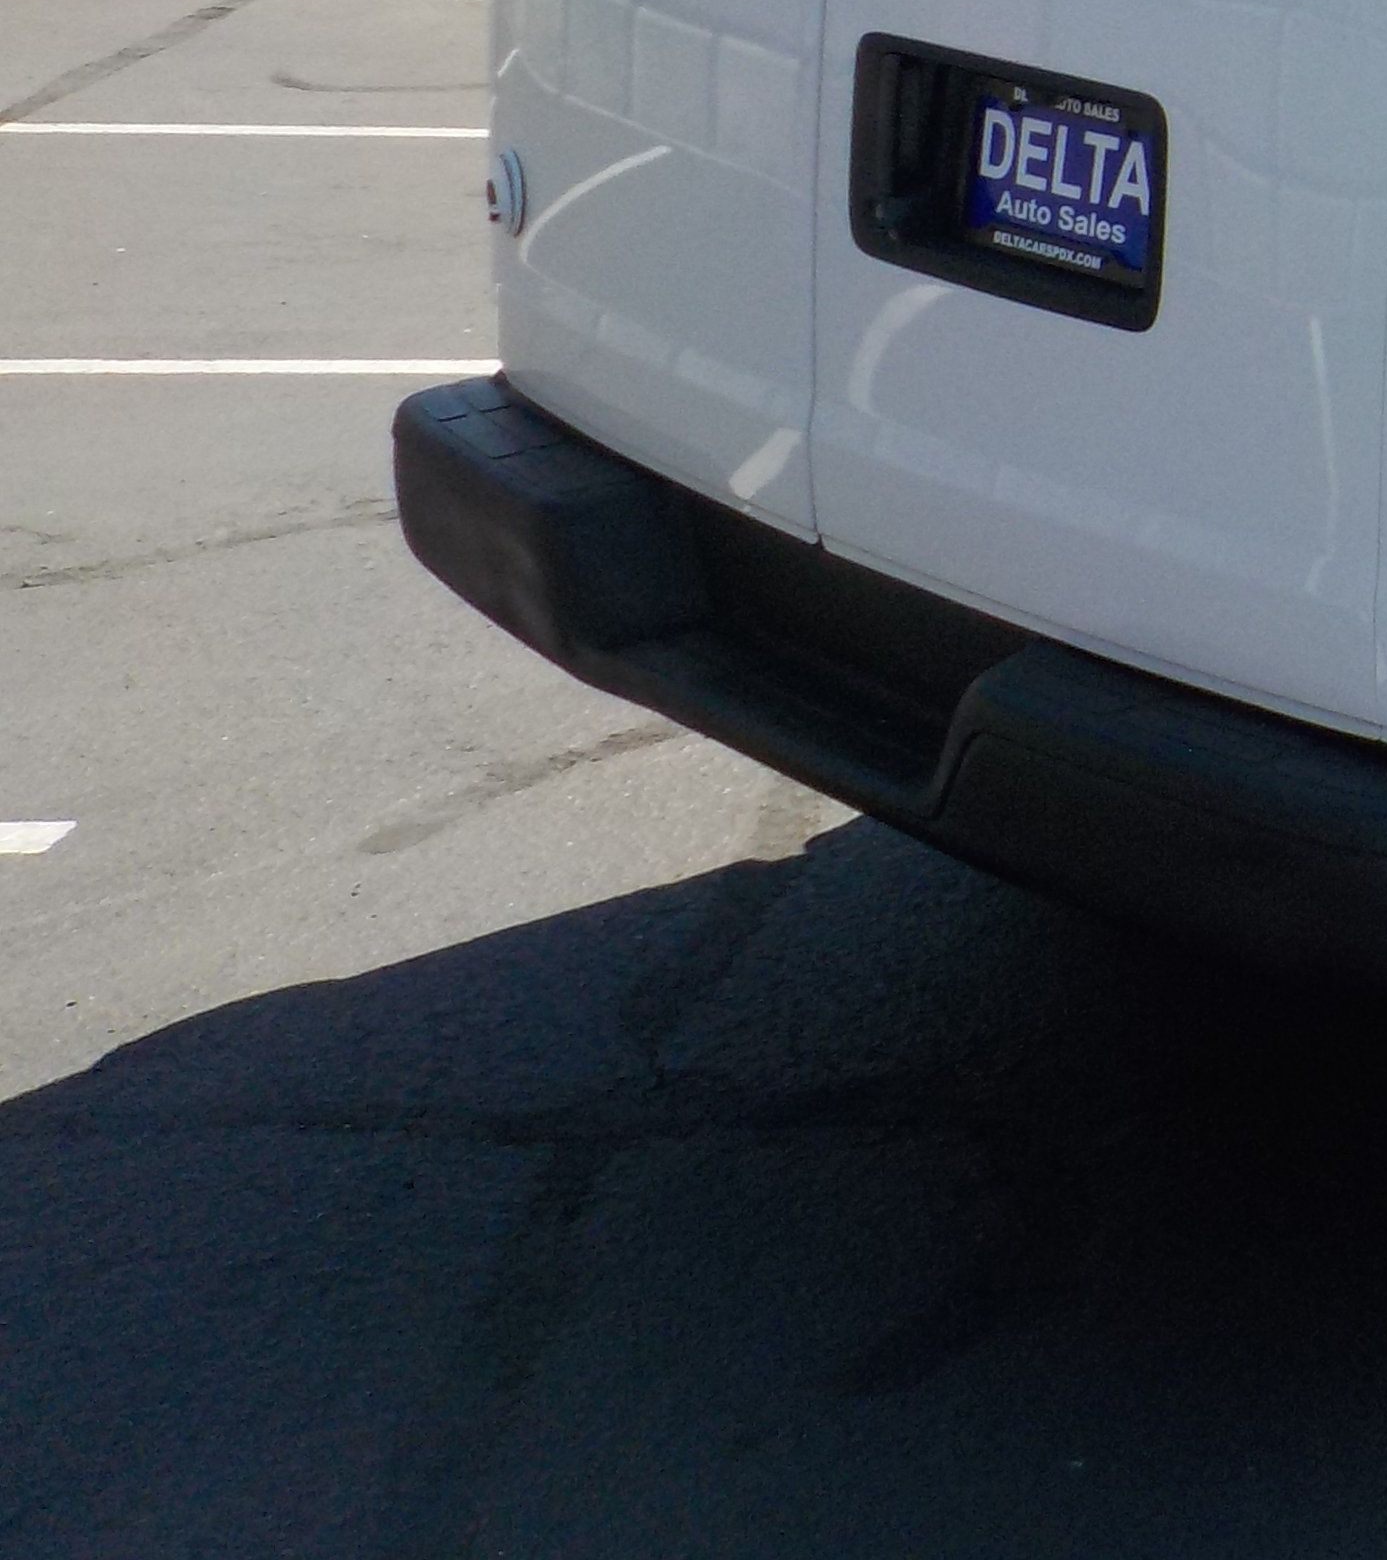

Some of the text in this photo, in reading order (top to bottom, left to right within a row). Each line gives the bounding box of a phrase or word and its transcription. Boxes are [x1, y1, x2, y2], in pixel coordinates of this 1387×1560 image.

[1083, 101, 1121, 124] SALES
[979, 107, 1150, 217] DELTA
[995, 190, 1127, 245] Auto Sales
